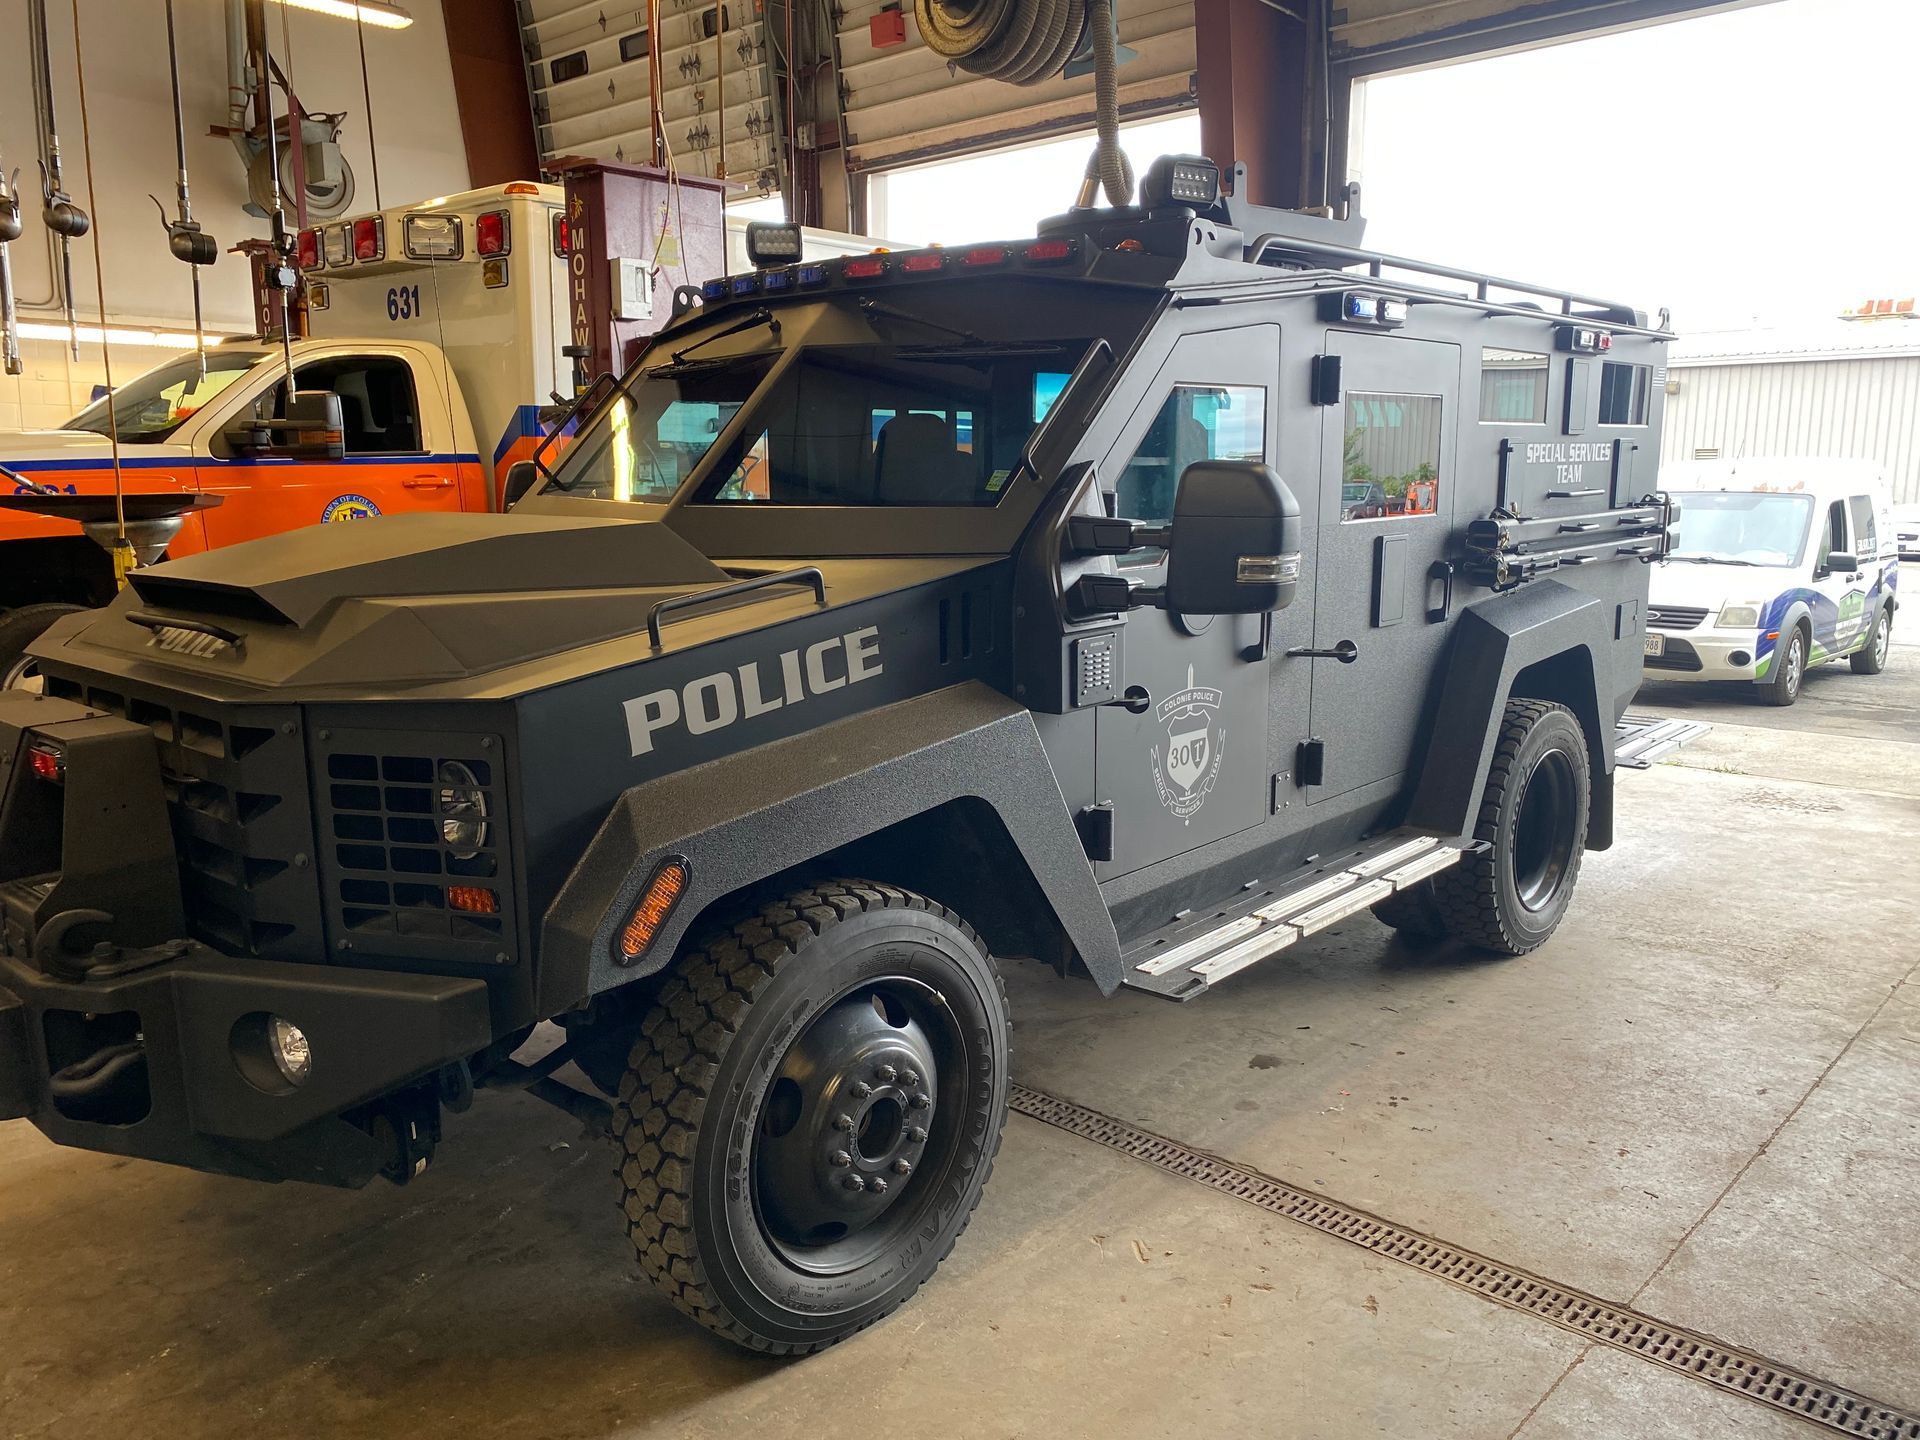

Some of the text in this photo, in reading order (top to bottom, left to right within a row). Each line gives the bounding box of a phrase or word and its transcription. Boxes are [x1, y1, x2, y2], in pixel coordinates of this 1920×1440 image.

[387, 284, 420, 321] 631
[1526, 443, 1611, 463] SPECIAL SERVICES
[1556, 464, 1582, 484] TEAM
[322, 499, 339, 523] TOWN
[340, 495, 351, 503] OF
[622, 625, 883, 757] POLICE
[1164, 691, 1214, 711] COLONIE POLICE
[1154, 767, 1167, 800] SPECIAL
